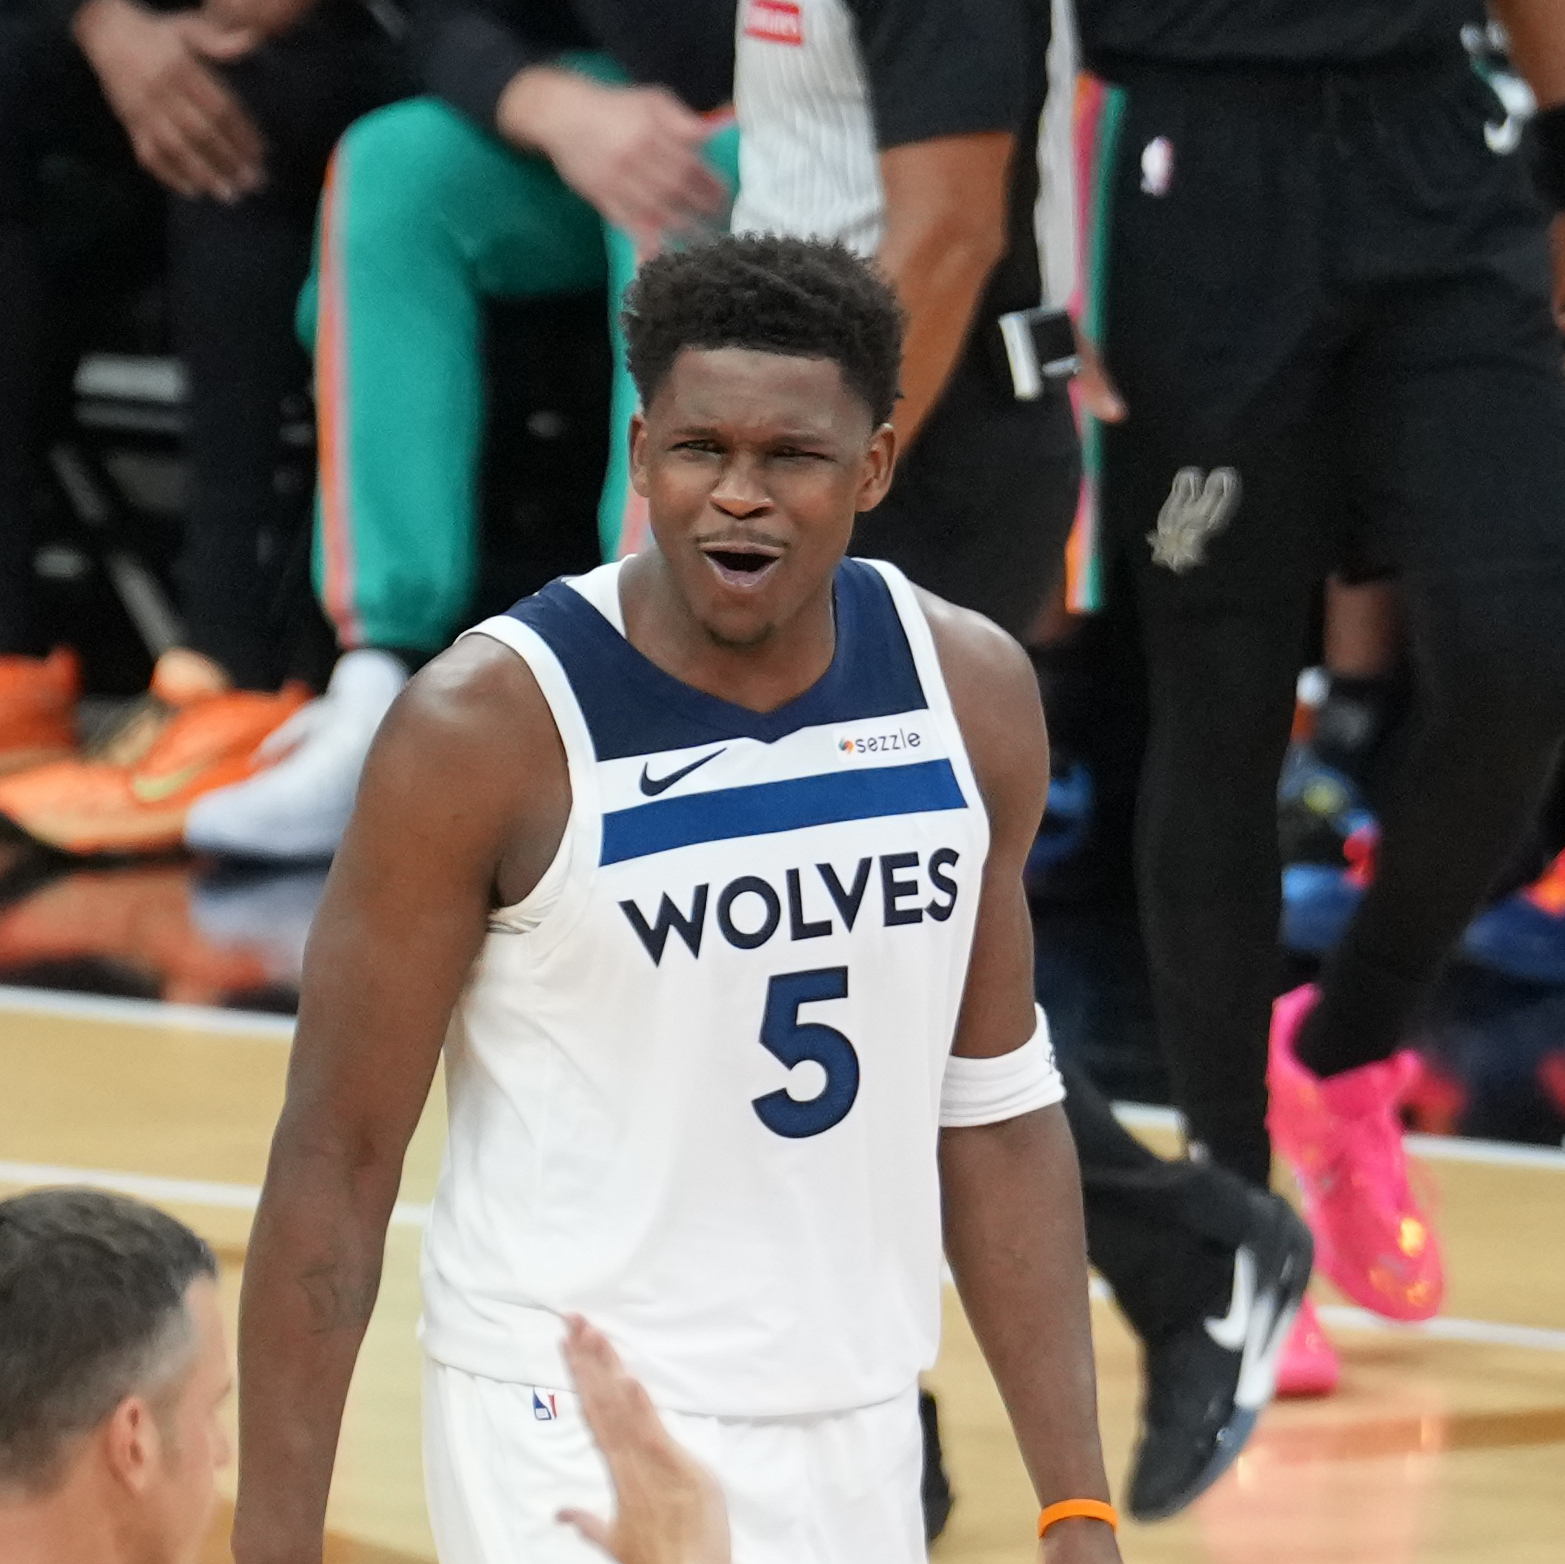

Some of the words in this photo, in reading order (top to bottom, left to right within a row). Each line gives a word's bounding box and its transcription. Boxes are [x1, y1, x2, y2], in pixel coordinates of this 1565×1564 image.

[855, 727, 921, 753] sezzle
[617, 847, 960, 968] WOLVES
[751, 965, 859, 1138] 5
